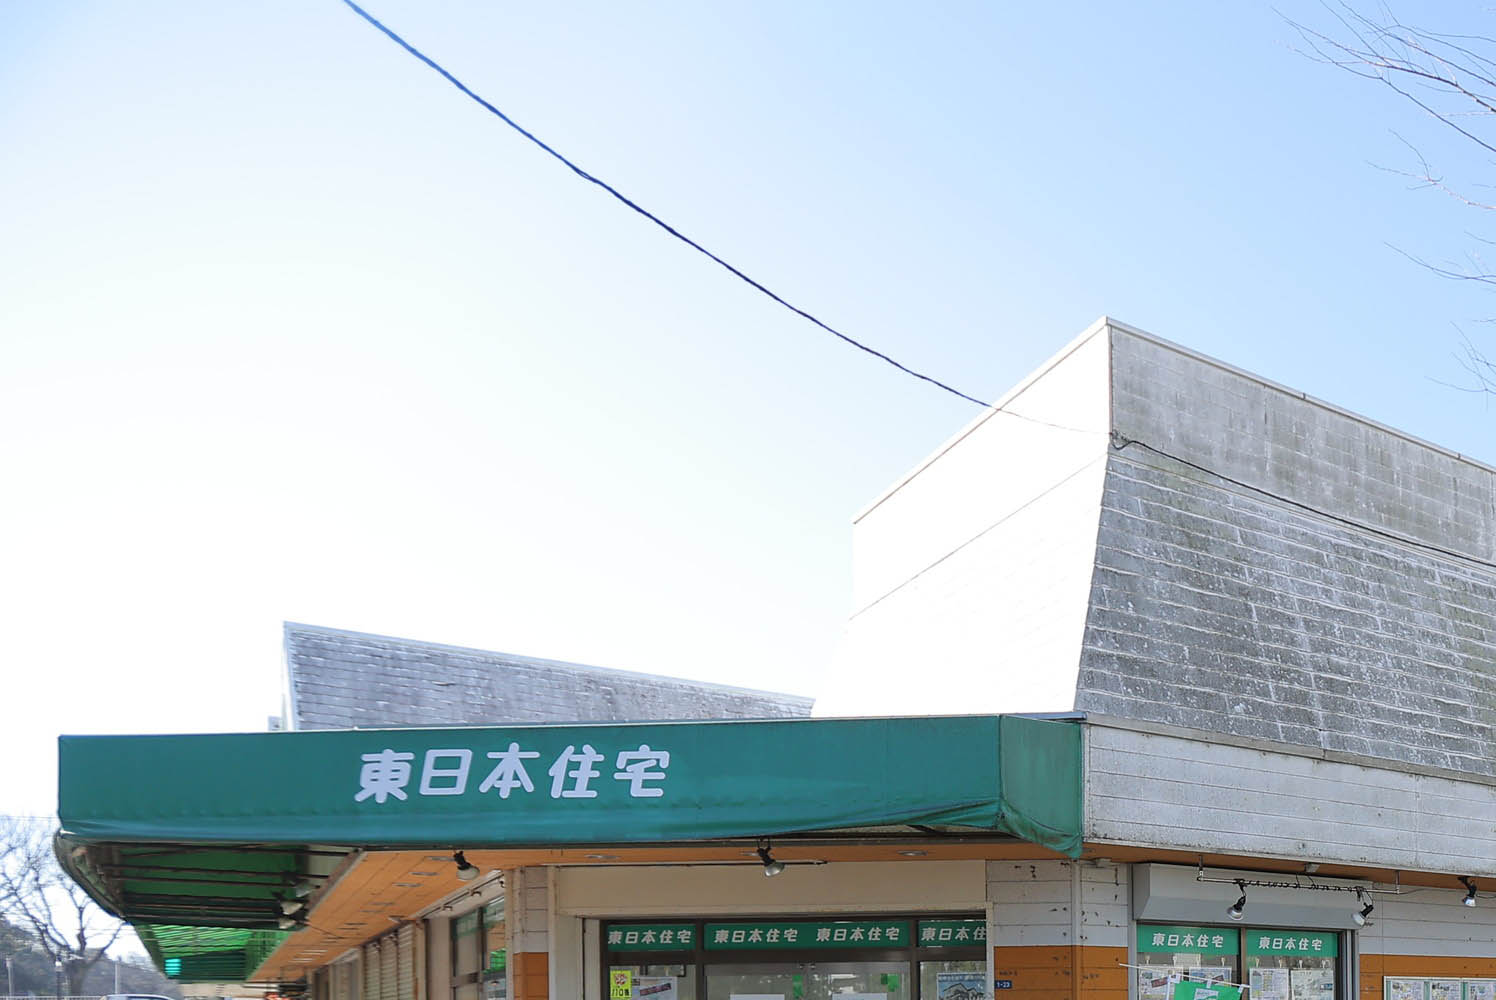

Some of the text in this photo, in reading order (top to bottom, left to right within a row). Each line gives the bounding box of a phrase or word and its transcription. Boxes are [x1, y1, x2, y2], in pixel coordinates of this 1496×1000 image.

[354, 742, 671, 803] 東日本住宅
[607, 929, 691, 945] 東日本住宅
[714, 928, 798, 944] 東日本住宅
[816, 926, 900, 942] 東日本住宅
[1152, 932, 1224, 948] 東日本住宅
[1259, 936, 1322, 951] 東日本住宅
